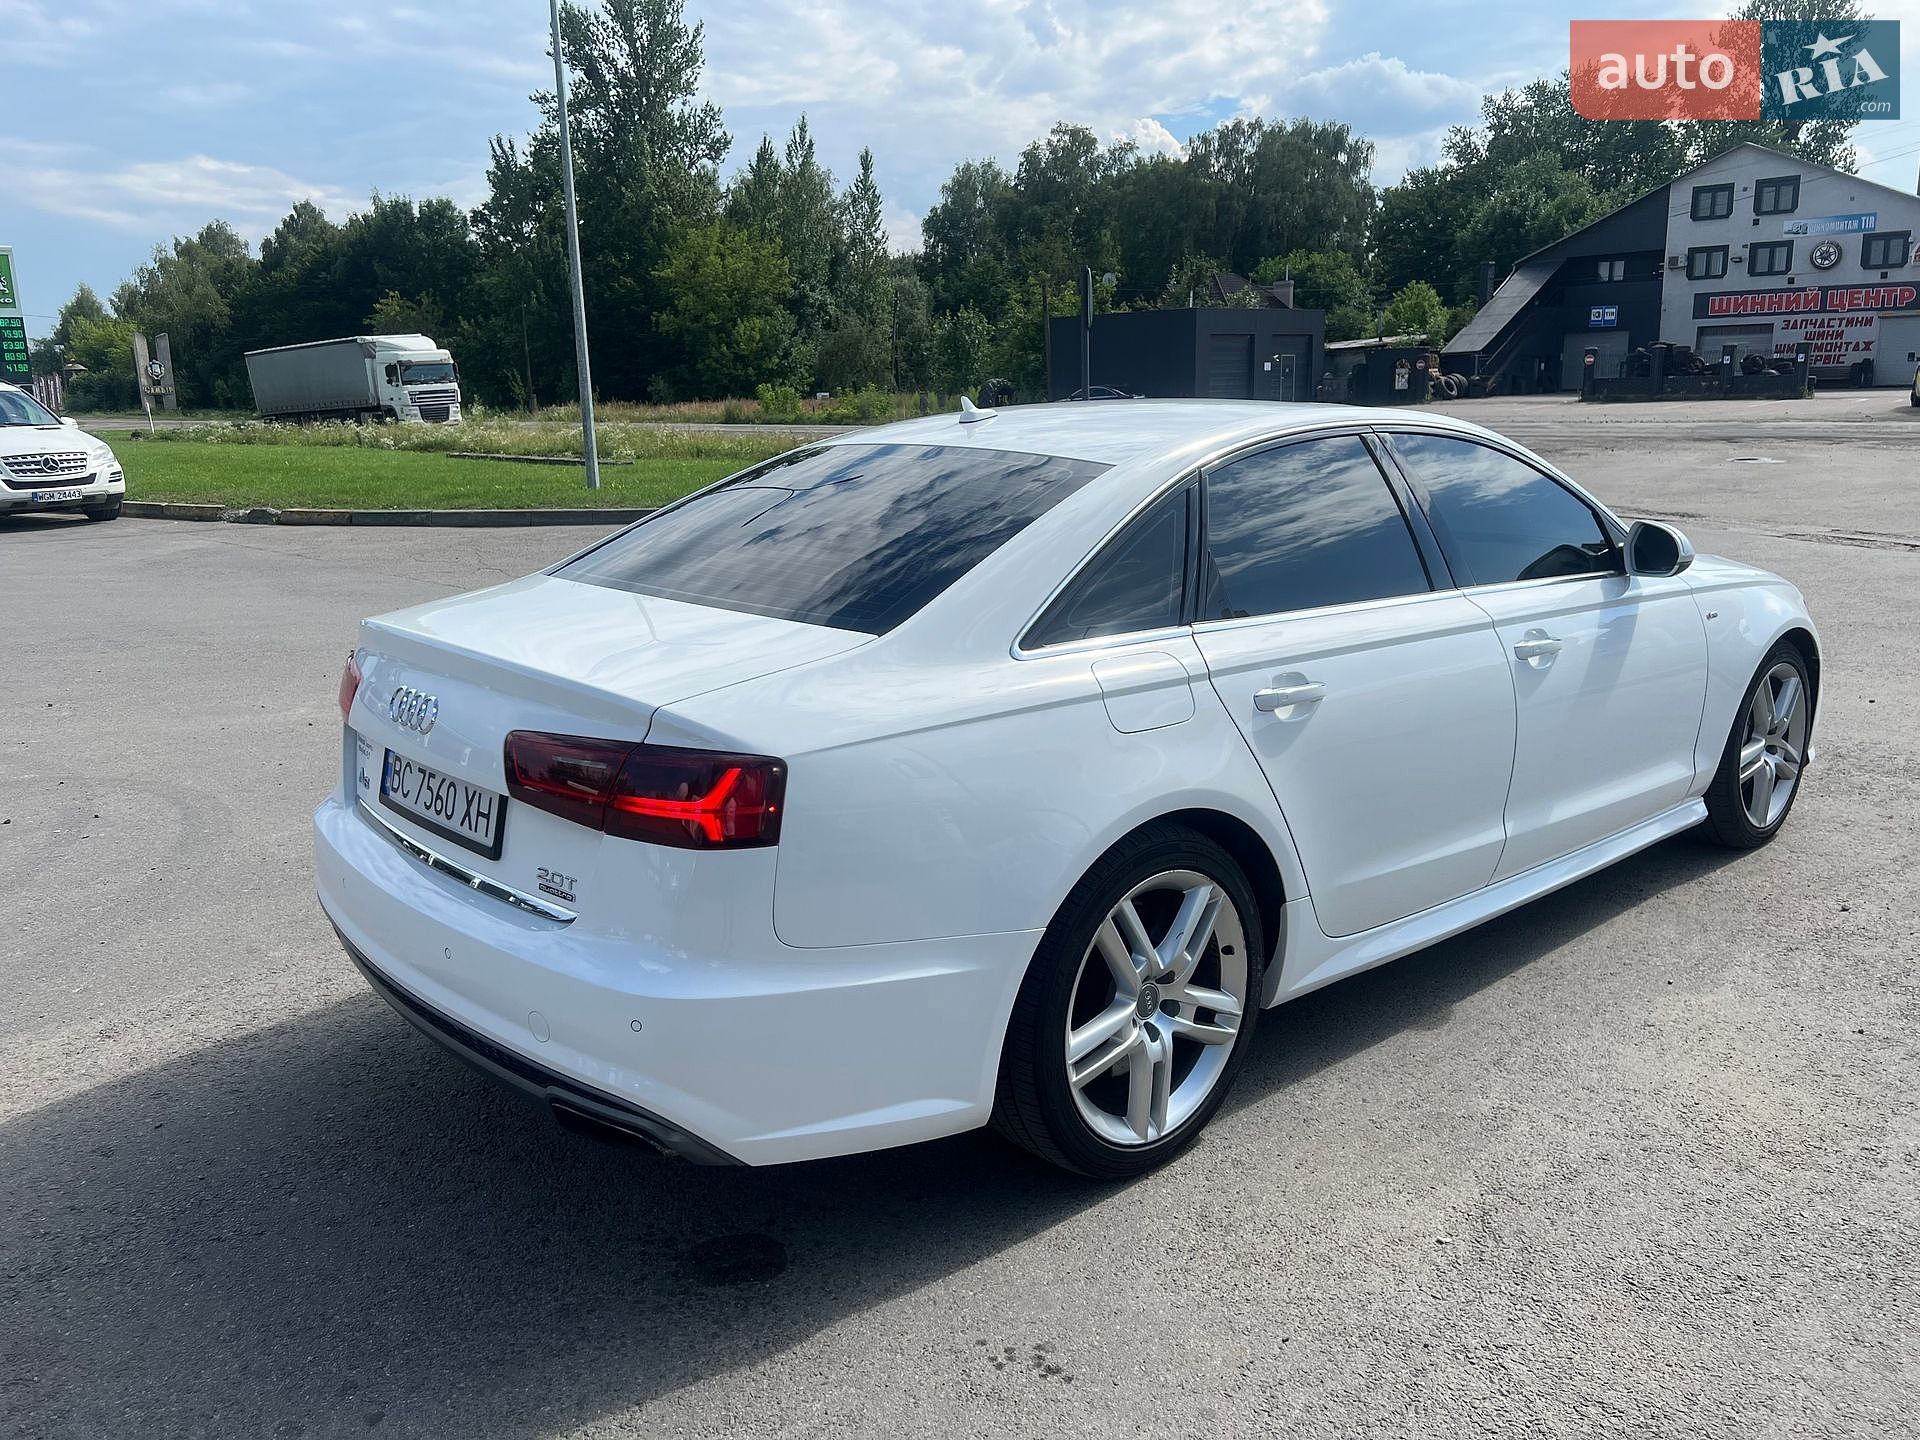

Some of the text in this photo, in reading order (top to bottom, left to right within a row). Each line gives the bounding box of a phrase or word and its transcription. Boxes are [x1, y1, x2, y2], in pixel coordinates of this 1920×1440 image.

[1709, 286, 1917, 315] ШИННИЙ ЦЕНТР
[1781, 316, 1874, 330] ЗАПЧАСТИНИ
[1803, 330, 1844, 341] ШИНИ
[1774, 341, 1874, 353] ШИМОНТАЖ
[1809, 354, 1846, 365] ЕРВІС
[391, 754, 493, 838] BC 7560 XH
